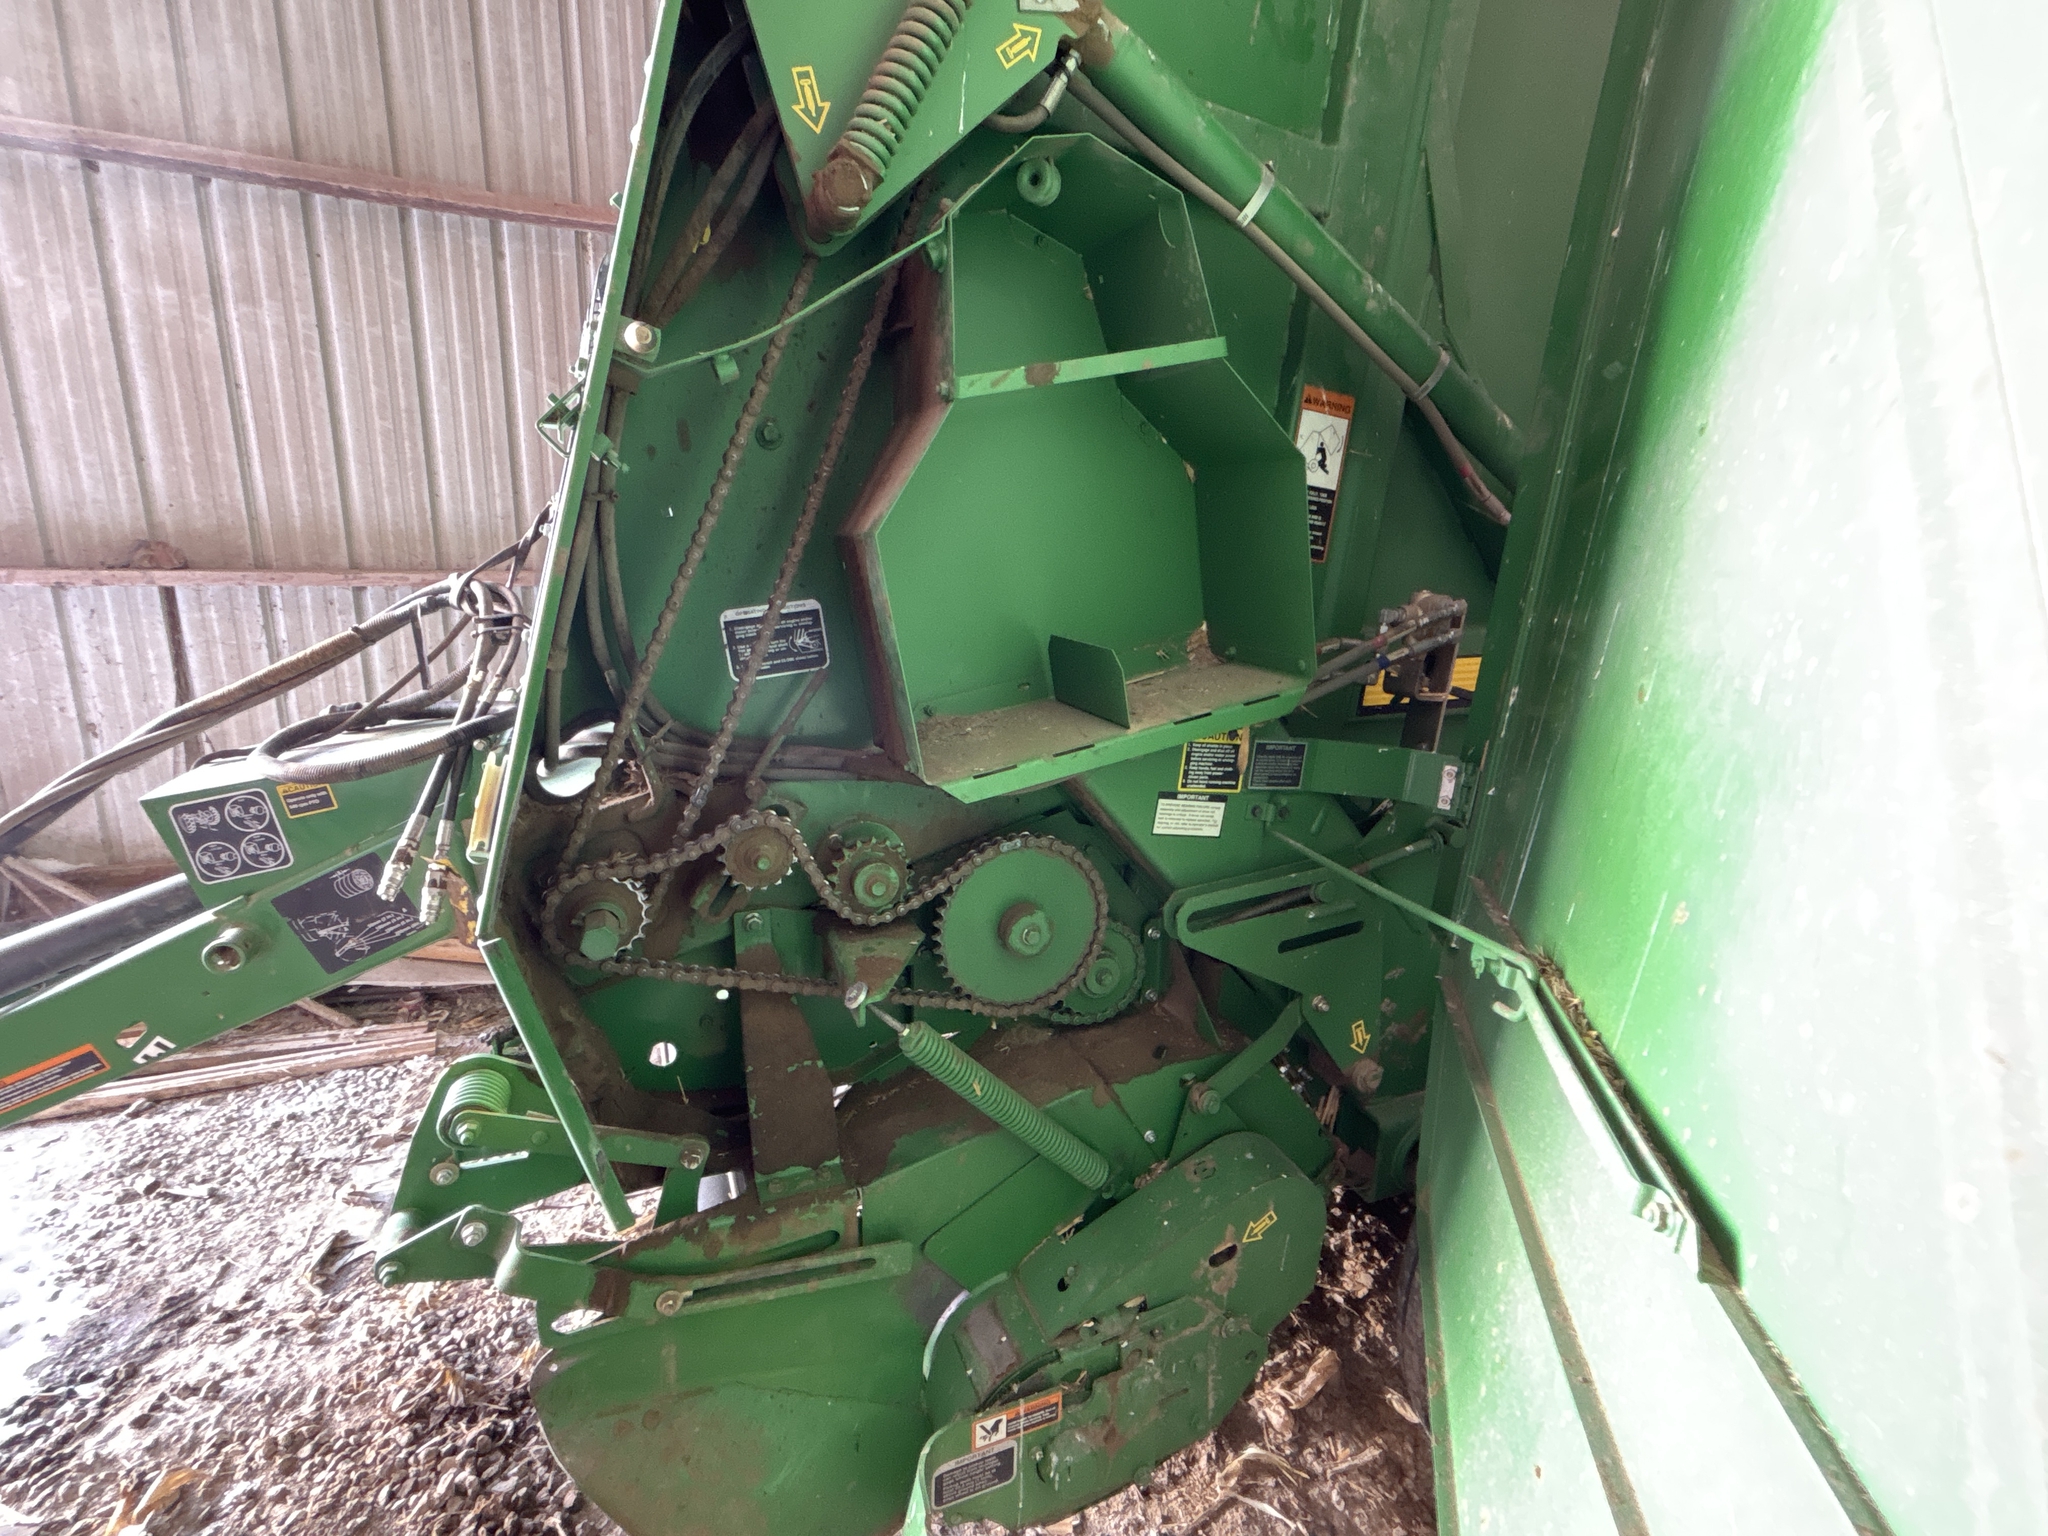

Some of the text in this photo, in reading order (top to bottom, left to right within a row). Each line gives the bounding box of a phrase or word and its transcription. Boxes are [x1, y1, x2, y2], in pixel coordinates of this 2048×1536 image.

[1313, 396, 1351, 414] WARNING
[1202, 732, 1242, 742] AUTIN
[1176, 793, 1210, 801] IMPORTANT
[954, 1447, 995, 1467] IMPORTANT
